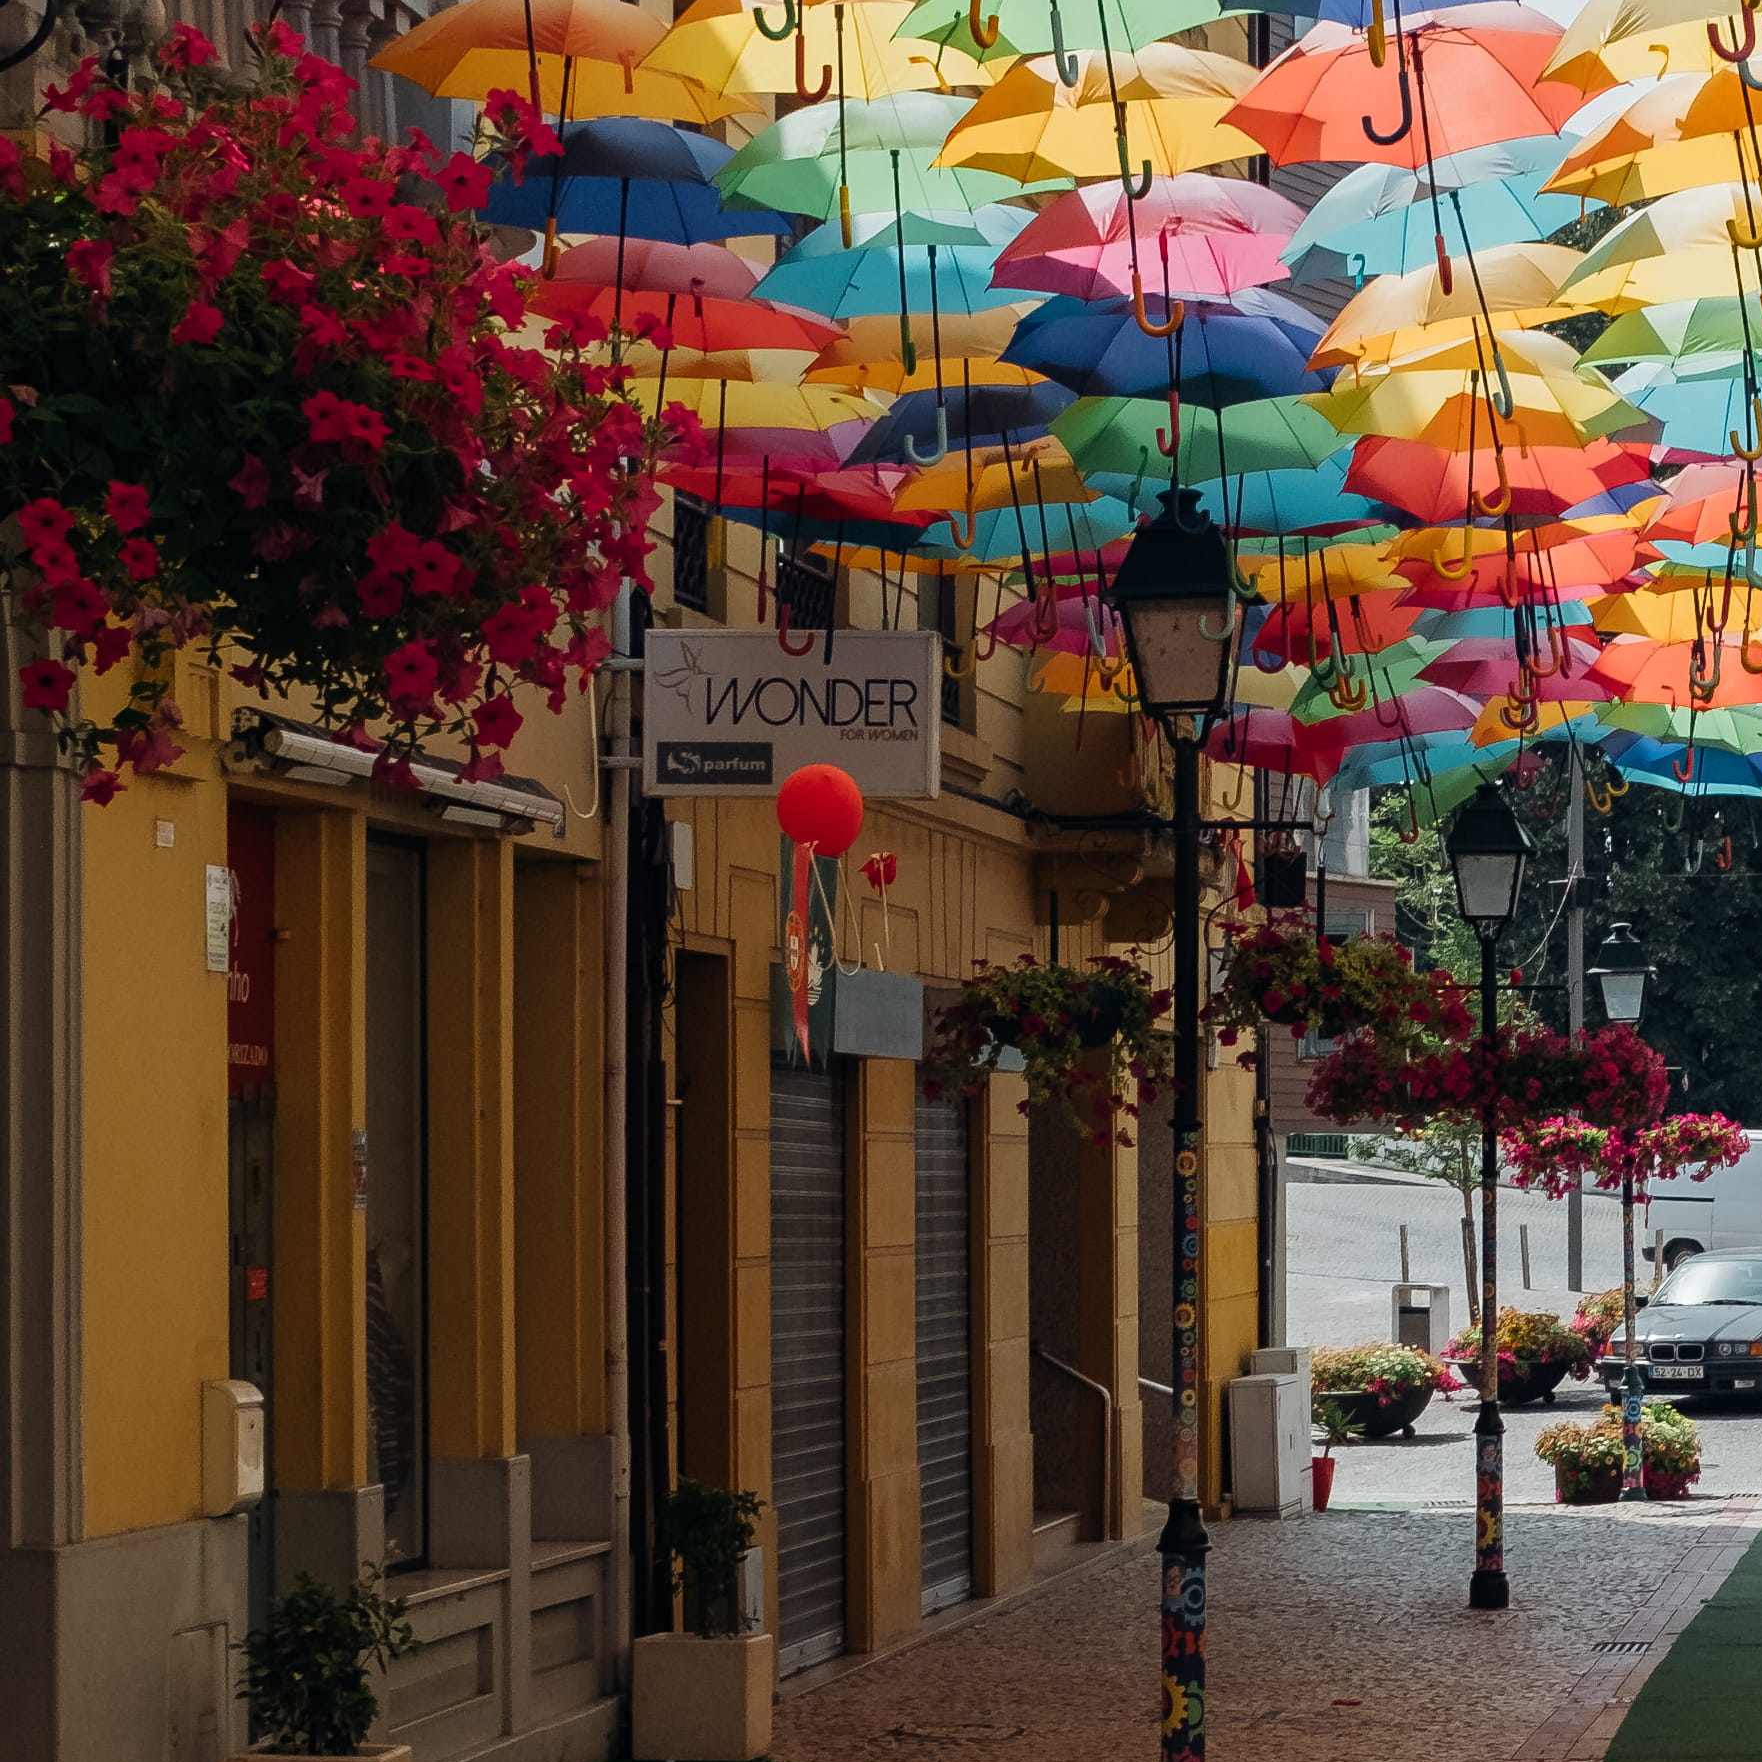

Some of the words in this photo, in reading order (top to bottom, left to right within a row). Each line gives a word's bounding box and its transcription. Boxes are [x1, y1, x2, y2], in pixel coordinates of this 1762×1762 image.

[706, 677, 918, 728] WONDER
[840, 728, 865, 741] FOR
[868, 728, 919, 742] WOMEN
[704, 757, 766, 774] parfum
